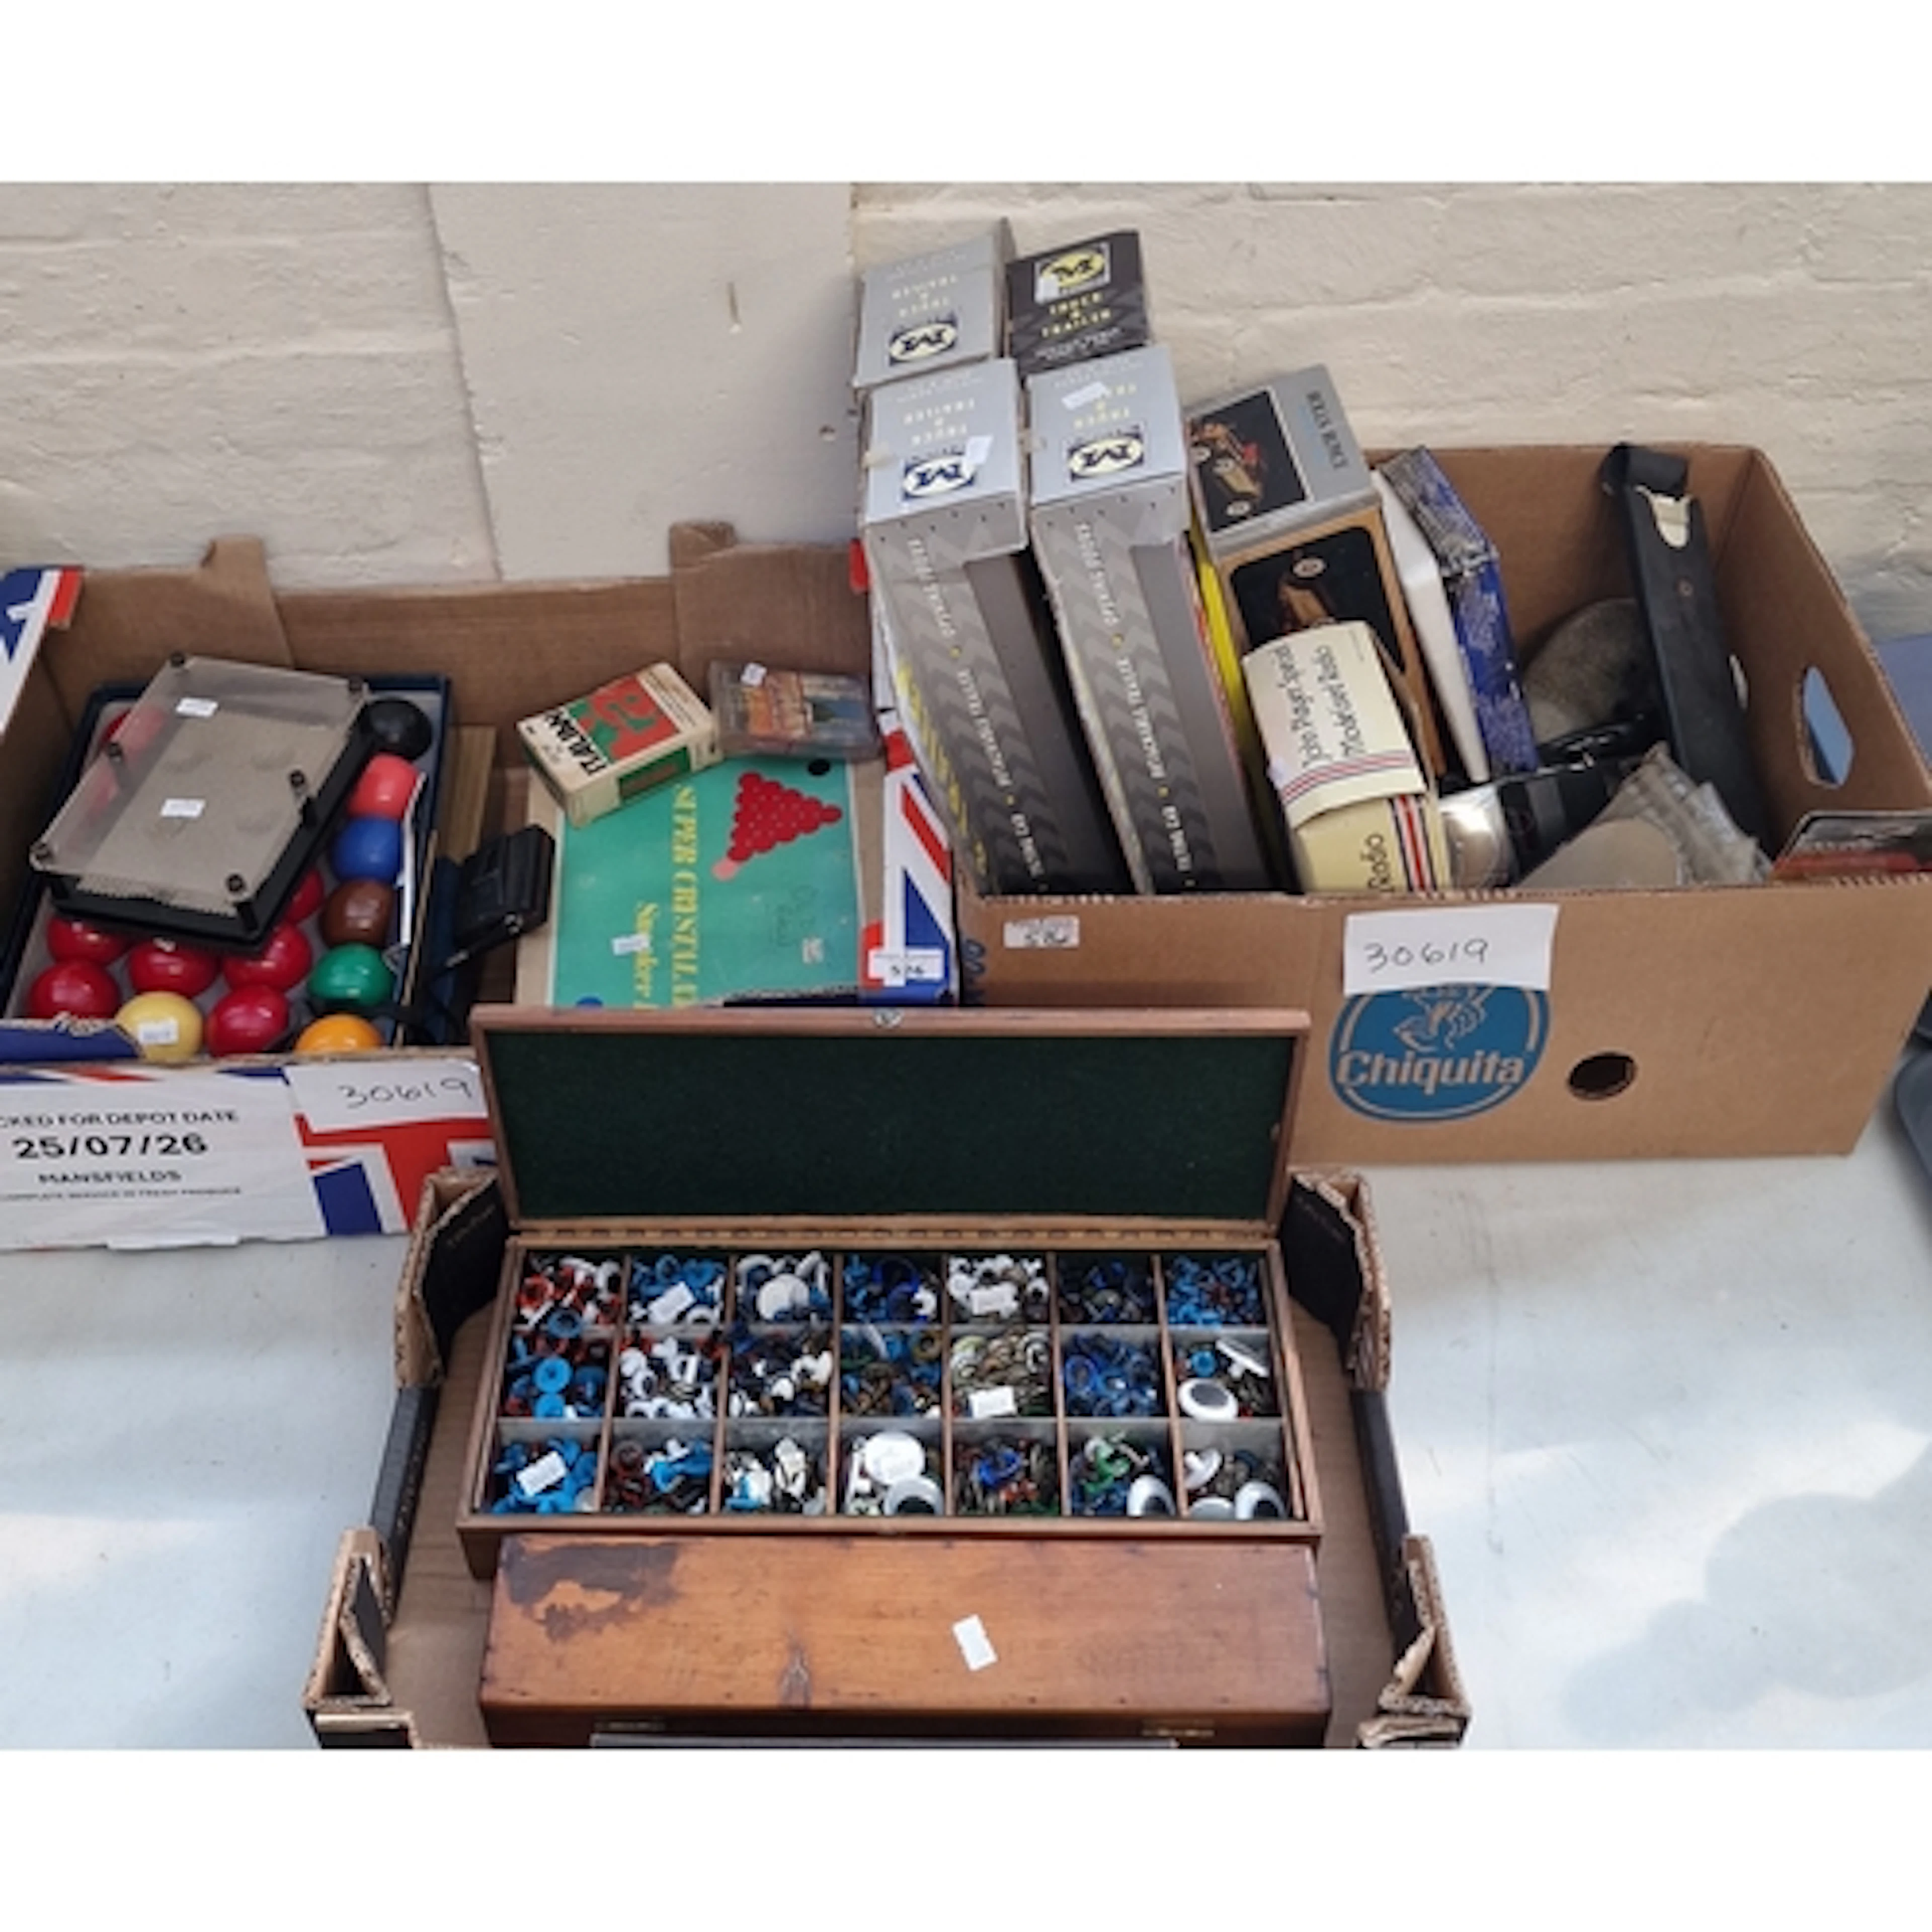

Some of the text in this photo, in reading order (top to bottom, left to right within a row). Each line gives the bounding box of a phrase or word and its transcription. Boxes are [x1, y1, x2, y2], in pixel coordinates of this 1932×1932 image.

[1364, 938, 1489, 973] 30619
[1336, 1050, 1524, 1096] Chiquita
[338, 1077, 472, 1108] 30619
[107, 1110, 176, 1125] DEPOT
[183, 1108, 240, 1123] DATE
[13, 1132, 207, 1159] 25/07/26
